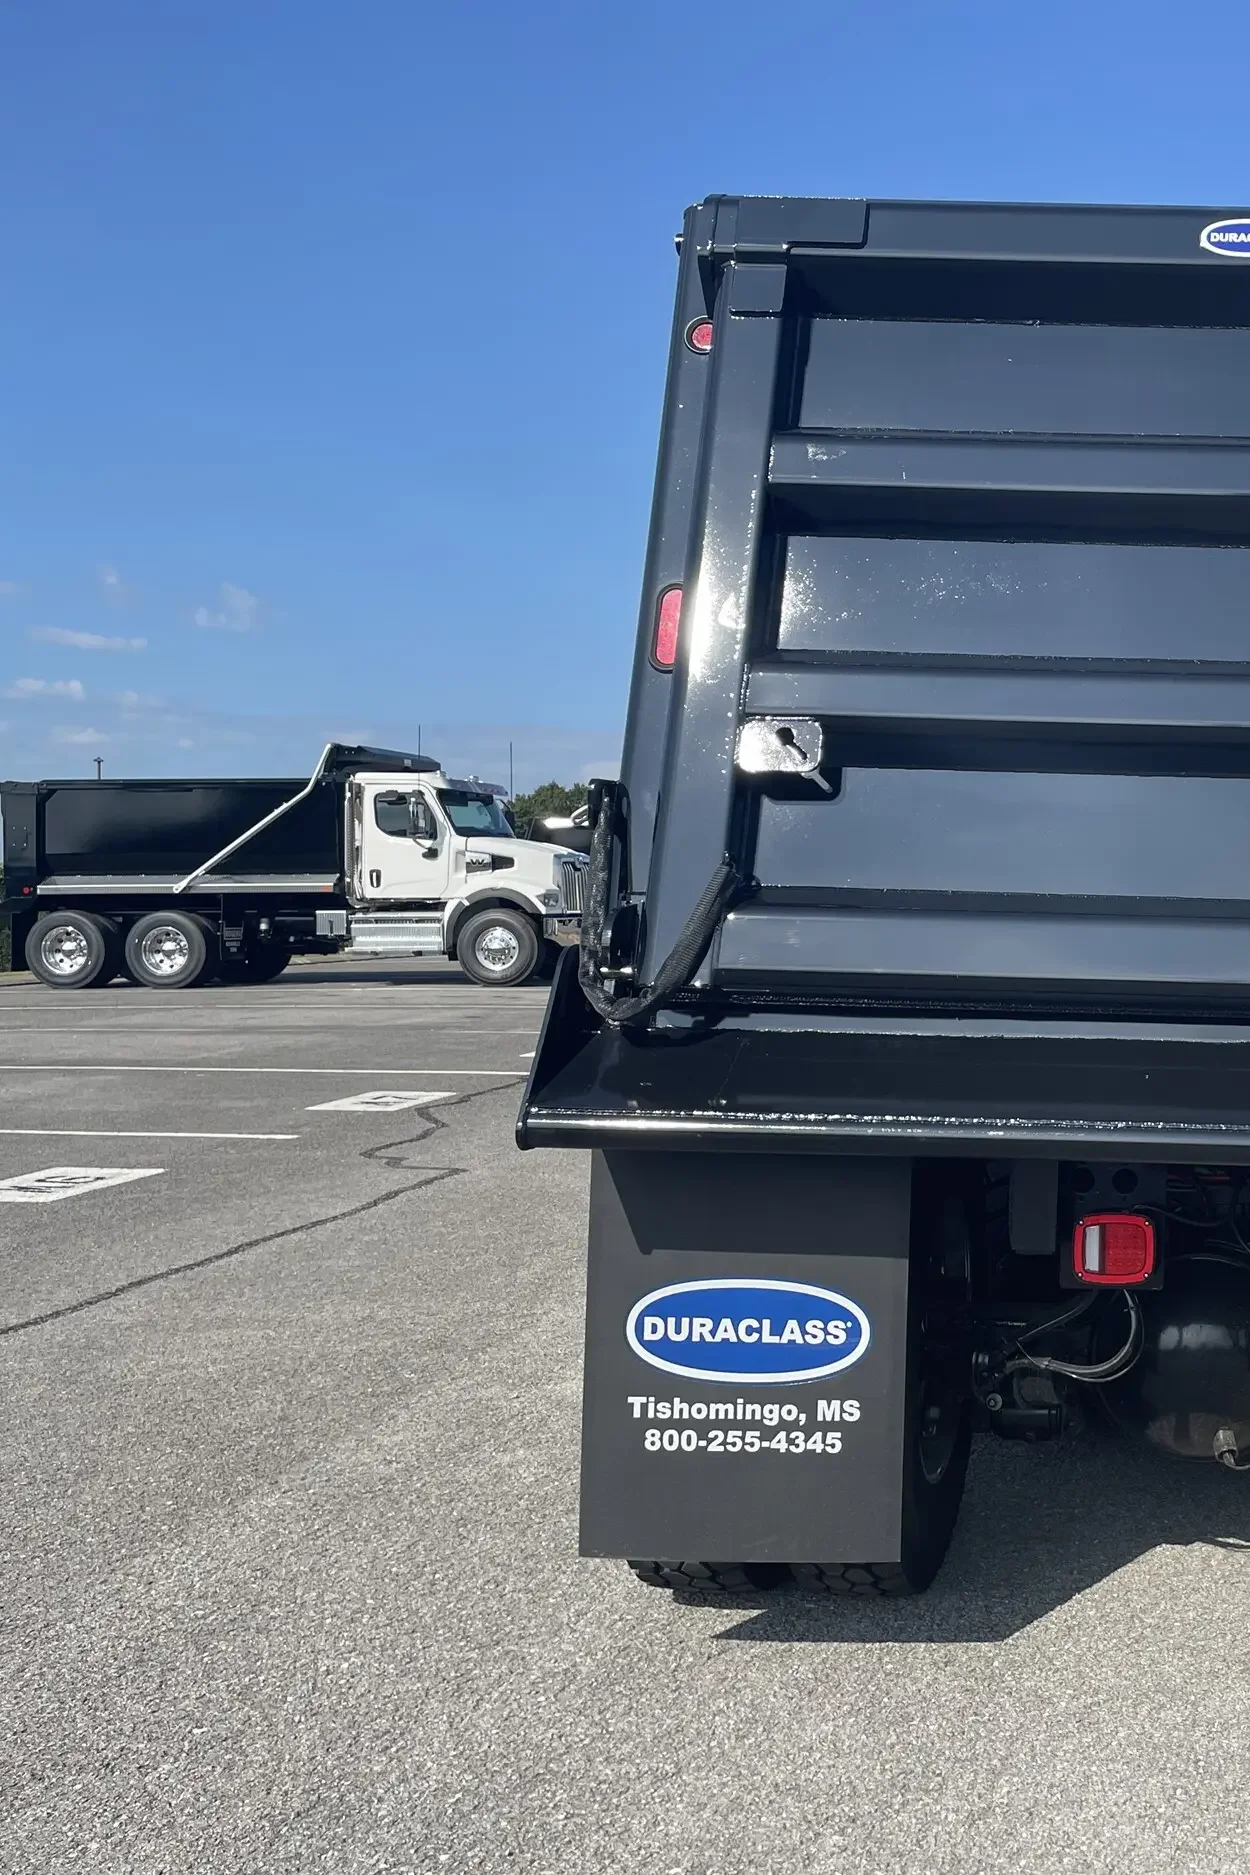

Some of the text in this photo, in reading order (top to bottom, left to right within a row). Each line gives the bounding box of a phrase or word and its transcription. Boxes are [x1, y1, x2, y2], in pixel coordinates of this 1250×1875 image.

[643, 1316, 847, 1345] DURACLASS
[627, 1396, 861, 1427] Tishomingo, MS
[644, 1428, 843, 1454] 800-255-4345
